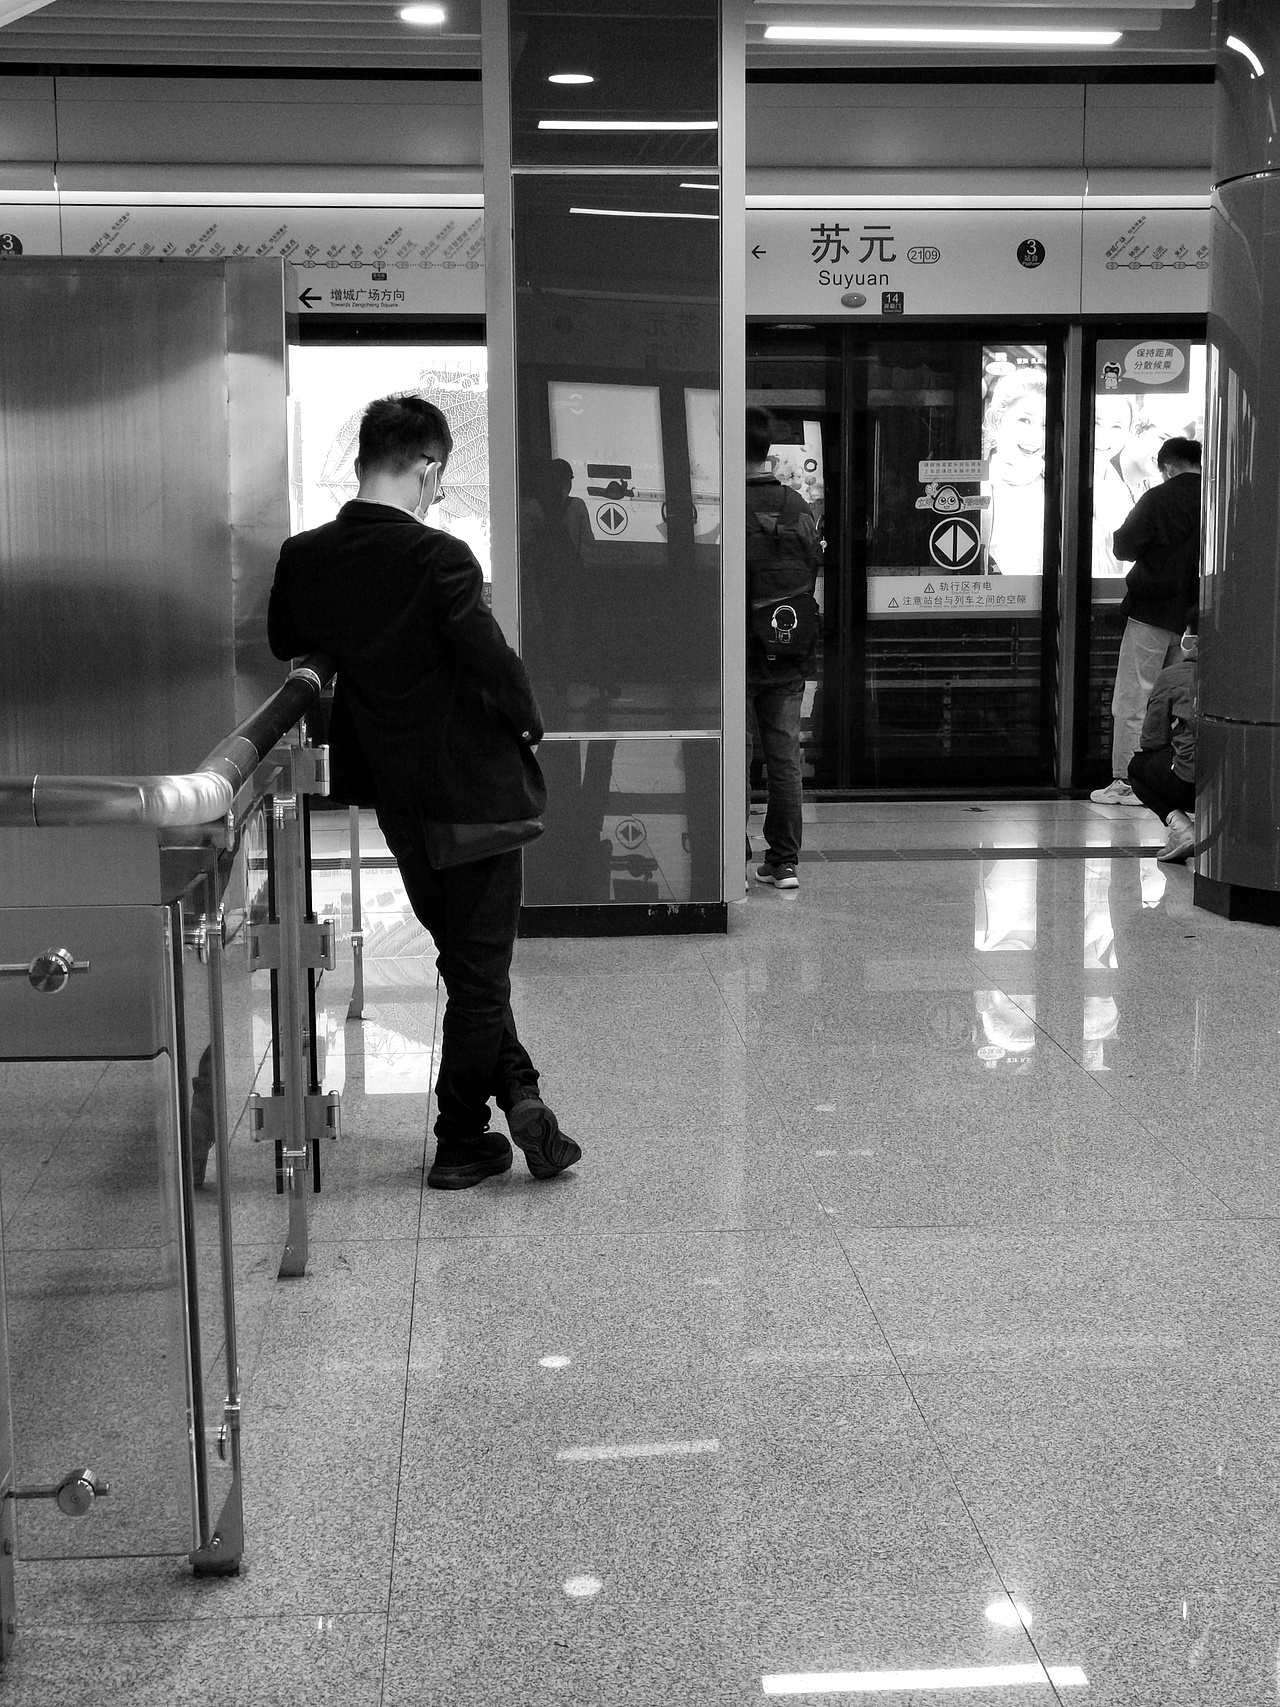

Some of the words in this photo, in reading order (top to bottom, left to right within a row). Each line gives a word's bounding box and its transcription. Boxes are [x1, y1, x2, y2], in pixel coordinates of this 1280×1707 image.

[3, 234, 14, 250] 3
[811, 223, 897, 263] 苏元
[1026, 240, 1037, 255] 3
[819, 270, 889, 289] Suyuan
[330, 288, 405, 301] 增城广场方向
[886, 293, 899, 303] 14
[1137, 348, 1174, 358] 保持距离
[939, 581, 993, 591] 轨行区有电
[903, 595, 1027, 605] 注意站台与列车之间的空隙
